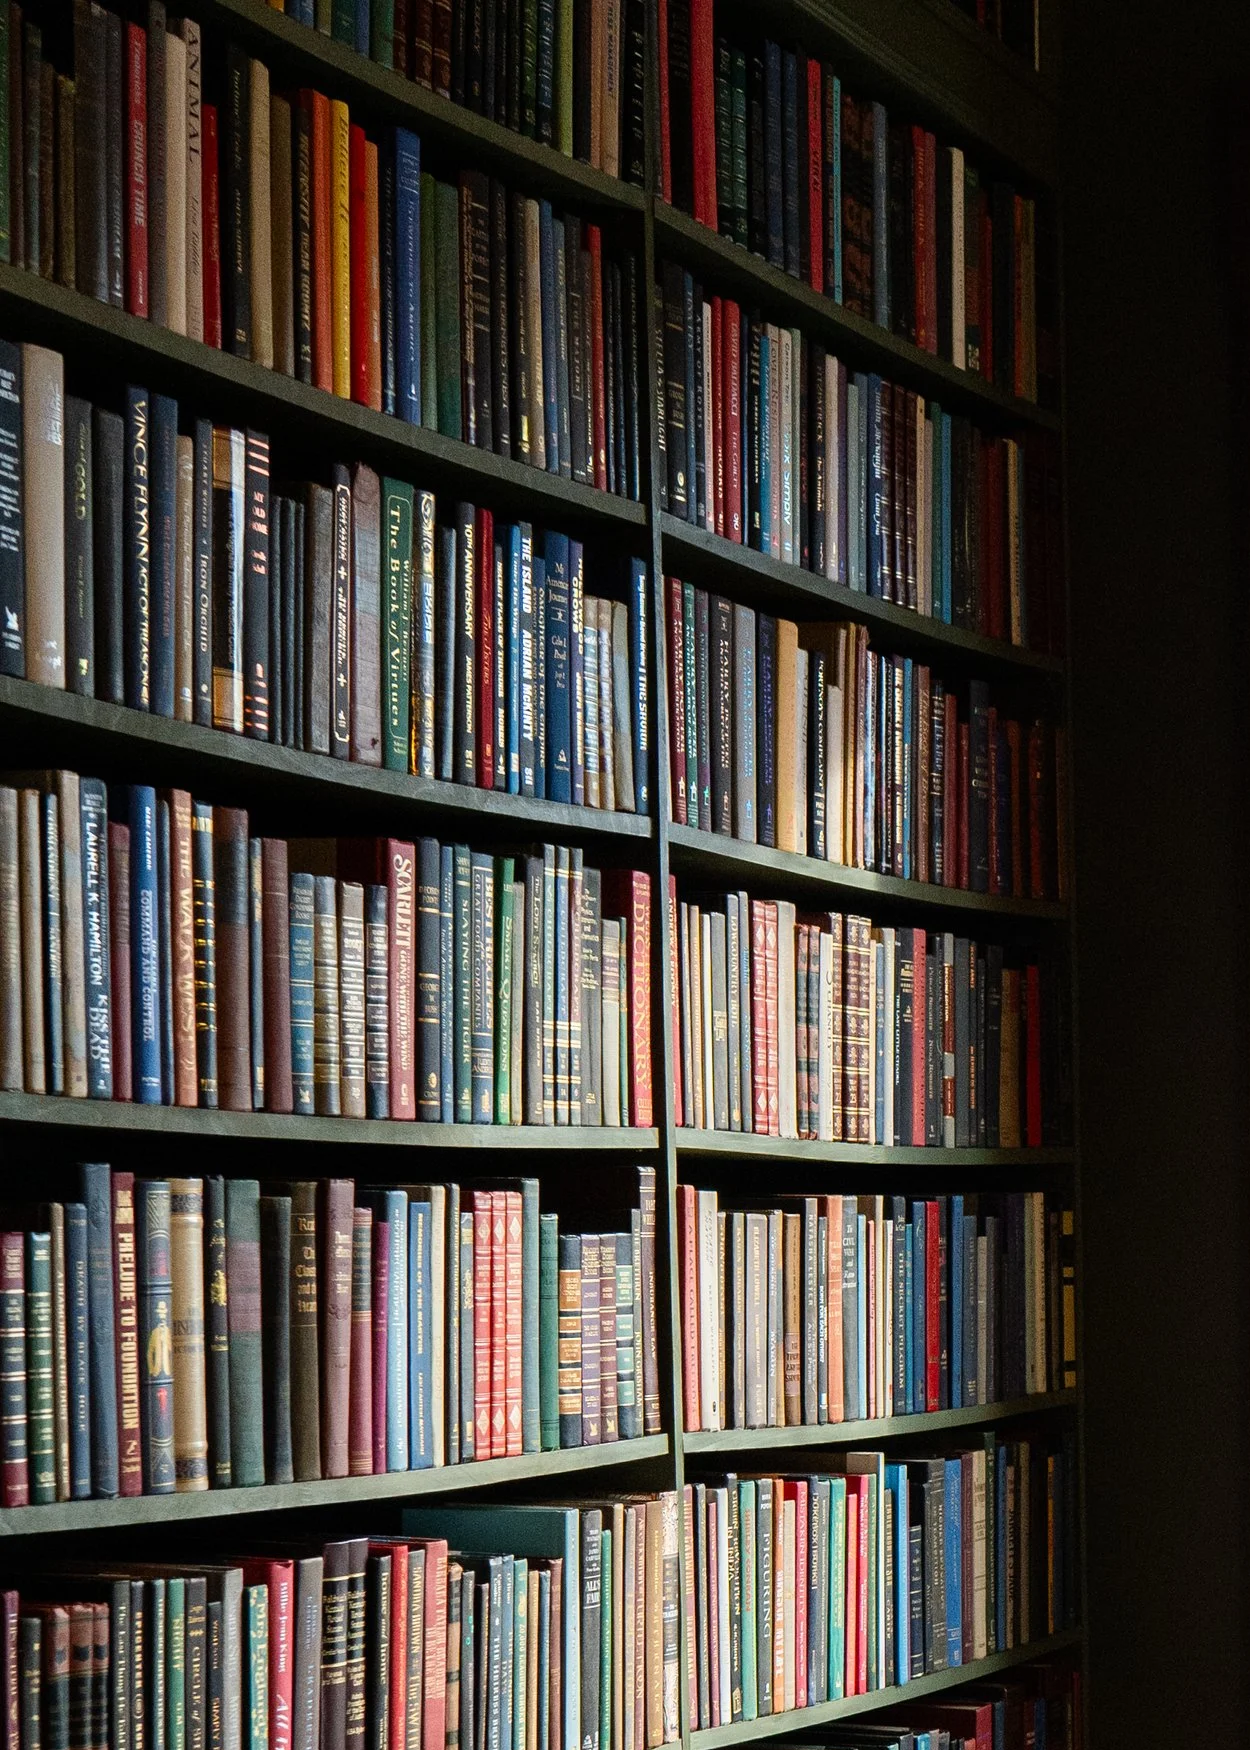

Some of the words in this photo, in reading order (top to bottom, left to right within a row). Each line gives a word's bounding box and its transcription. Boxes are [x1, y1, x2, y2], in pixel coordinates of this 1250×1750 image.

[188, 28, 200, 163] ANIMAL
[134, 120, 145, 183] CRUNCH
[339, 116, 349, 197] Believe
[134, 189, 145, 226] TIME
[133, 400, 149, 477] VINCE
[657, 390, 666, 451] STARLIGHT
[134, 483, 149, 562] FLYNN
[783, 471, 791, 526] Simply
[390, 505, 400, 548] The
[522, 537, 531, 561] THE
[139, 563, 149, 594] ACT
[200, 553, 209, 589] IRON
[390, 558, 400, 612] Book
[465, 549, 473, 640] ANNIVERSARY
[522, 565, 531, 613] ISLAND
[200, 593, 209, 653] ORCHID
[389, 620, 399, 643] of
[523, 630, 532, 678] ADRIAN
[391, 647, 400, 727] Virtues
[523, 683, 533, 741] McKINTY
[921, 720, 929, 755] Book
[86, 821, 99, 888] LAURELL
[180, 837, 191, 878] THE
[88, 892, 99, 906] K.
[141, 889, 151, 954] COMMAND
[180, 888, 193, 963] WALK
[392, 853, 412, 949] SCARLETT
[485, 876, 493, 930] BEST
[533, 896, 541, 930] LOST
[89, 911, 103, 985] HAMILTON
[462, 899, 470, 971] SLAYING
[504, 916, 513, 970] SMART
[532, 935, 541, 987] SYMBOL
[142, 958, 151, 984] AND
[462, 976, 470, 1010] THE
[485, 937, 493, 1030] RECIPES
[633, 901, 647, 1091] DICTIONARY
[89, 1007, 101, 1059] DEAD
[97, 994, 109, 1032] KISS
[143, 986, 152, 1041] CONTROL
[181, 973, 194, 1043] WEST
[499, 978, 511, 1072] QUESTIONS
[731, 999, 739, 1028] BOIL
[462, 1016, 470, 1064] TIGER
[118, 1232, 134, 1302] PRELUDE
[417, 1270, 423, 1286] OF
[120, 1305, 135, 1326] TO
[121, 1332, 139, 1429] FOUNDATION
[380, 1572, 389, 1615] house
[412, 1567, 421, 1611] SANDRA
[763, 1533, 771, 1638] FIGURING
[256, 1602, 266, 1638] Mrs
[116, 1658, 126, 1693] Thing
[192, 1645, 201, 1704] CIRCLE
[255, 1644, 267, 1728] England
[379, 1643, 388, 1685] home
[212, 1697, 220, 1740] SIMPLY
[276, 1695, 289, 1728] All
